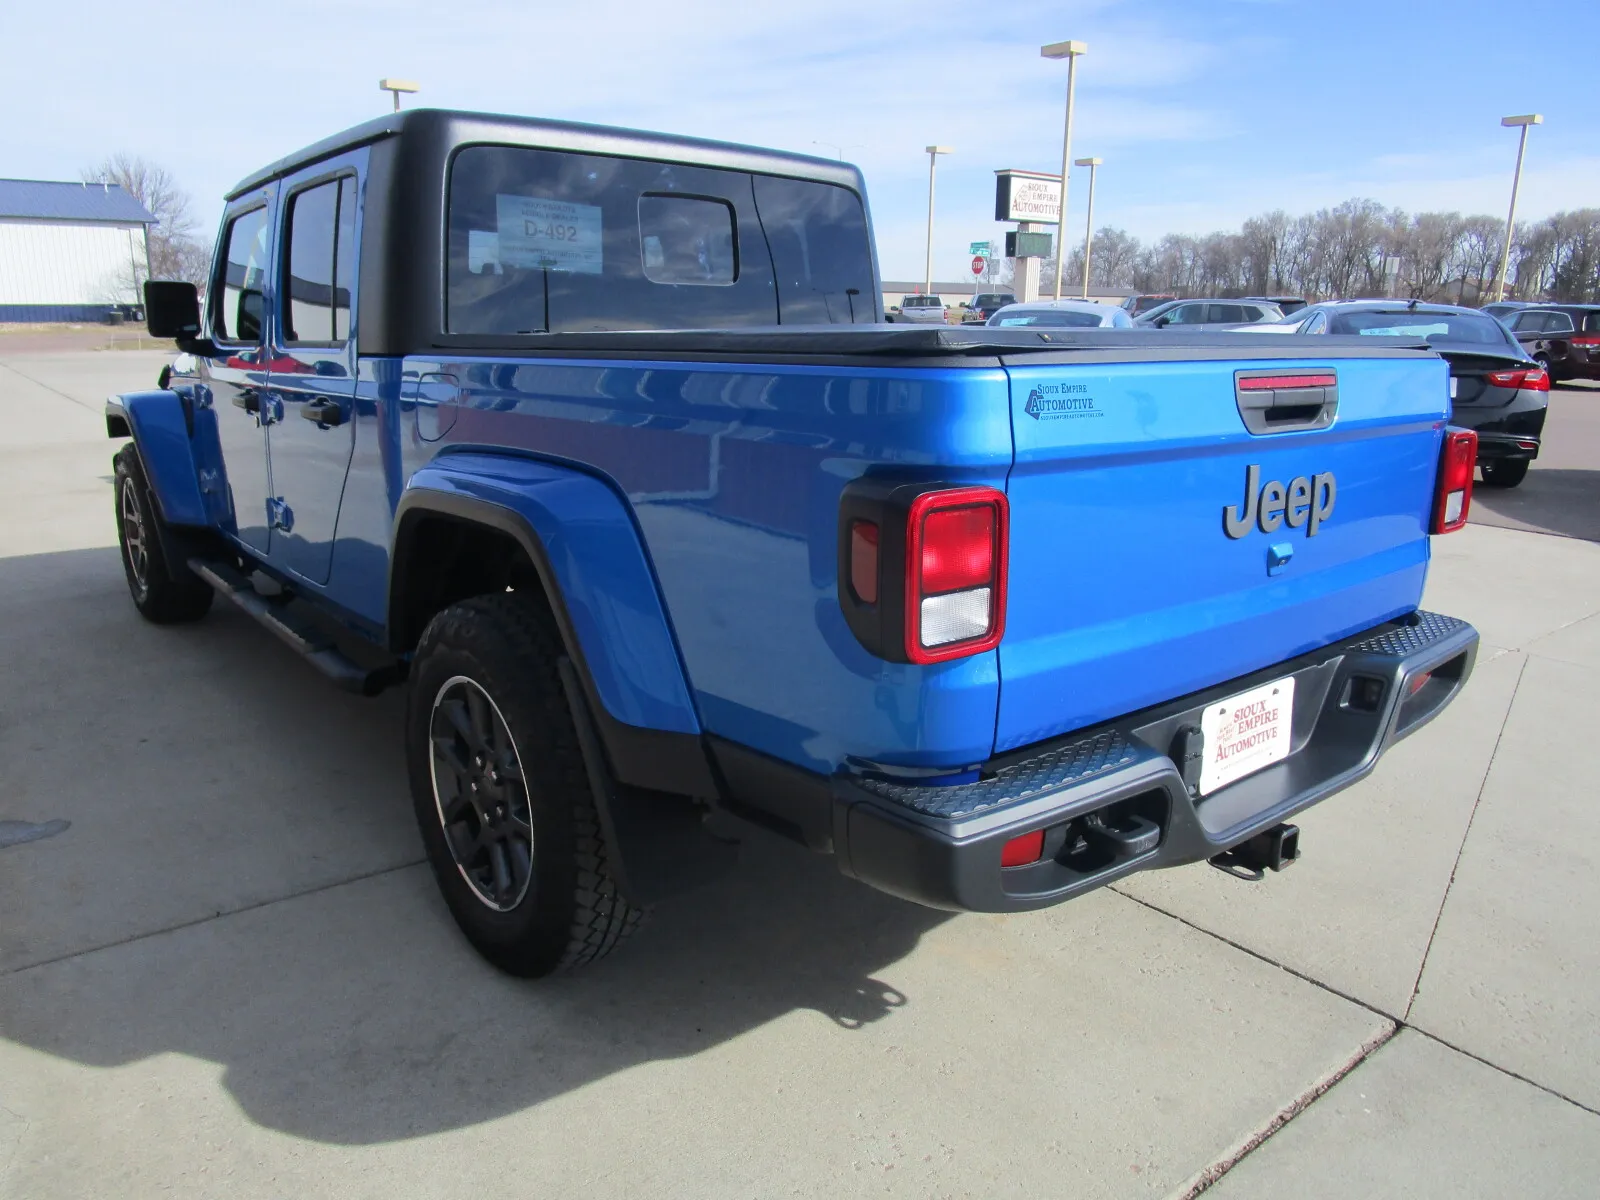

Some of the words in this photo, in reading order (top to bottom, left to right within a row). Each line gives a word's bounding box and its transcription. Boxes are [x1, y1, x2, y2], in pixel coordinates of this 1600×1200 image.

[1028, 183, 1048, 192] SIOUX
[1032, 192, 1058, 202] EMPIRE
[524, 219, 577, 242] D-492
[1037, 384, 1060, 394] SIOUX
[1061, 383, 1087, 393] EMPIRE
[1031, 398, 1094, 412] AUTOMOTIVE
[1222, 464, 1337, 540] Jeep
[1234, 700, 1267, 723] SIOUX
[1238, 708, 1279, 735] EMPIRE
[1215, 727, 1278, 763] AUTOMOTIVE
